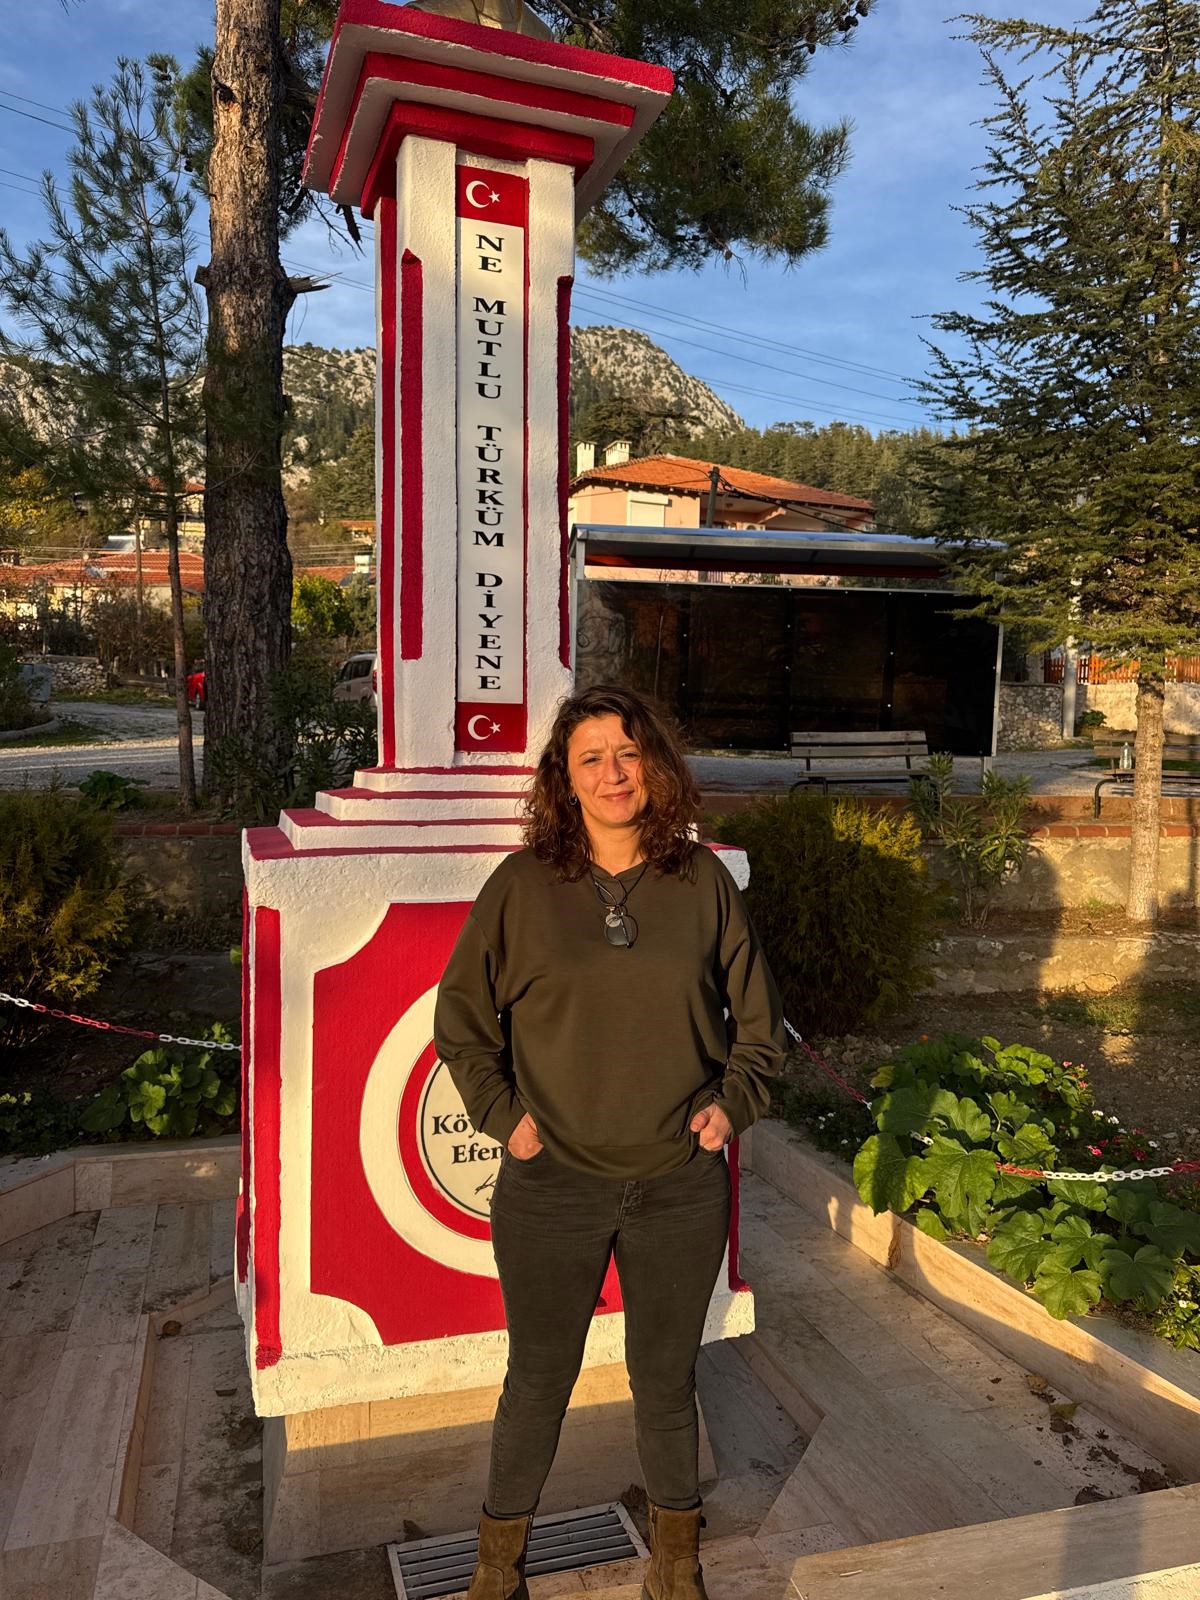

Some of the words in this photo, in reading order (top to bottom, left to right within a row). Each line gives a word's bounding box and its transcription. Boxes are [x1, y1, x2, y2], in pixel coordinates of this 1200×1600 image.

[475, 233, 504, 273] NE
[473, 296, 507, 399] MUTLU
[473, 425, 504, 547] TÜRKÜM
[475, 572, 503, 690] DİYENE
